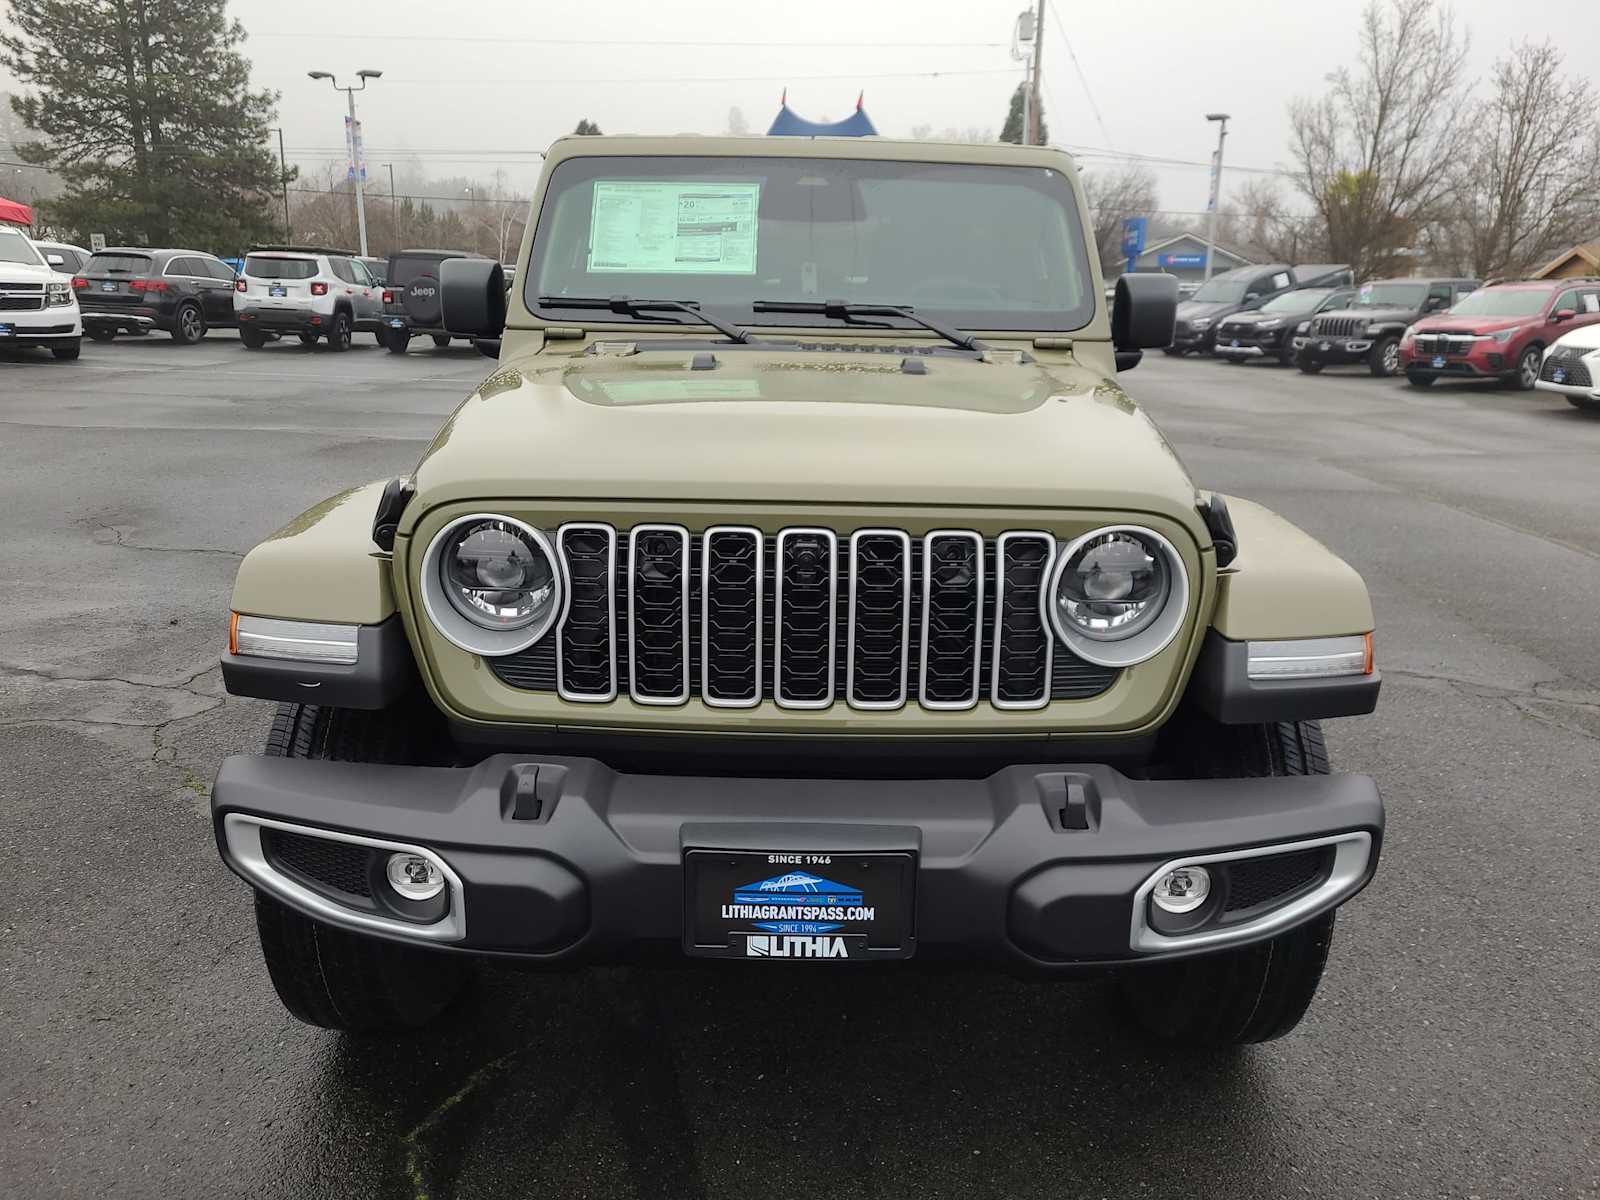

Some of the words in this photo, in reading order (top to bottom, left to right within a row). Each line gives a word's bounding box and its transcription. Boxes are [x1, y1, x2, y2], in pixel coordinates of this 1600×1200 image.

[683, 200, 695, 209] 20
[410, 286, 435, 297] Jeep
[768, 855, 802, 864] SINCE
[805, 855, 832, 864] 1946
[721, 904, 875, 921] LITHIAGRANTSPASS.COM
[778, 923, 799, 933] SINCE
[769, 936, 849, 958] LITHIA
